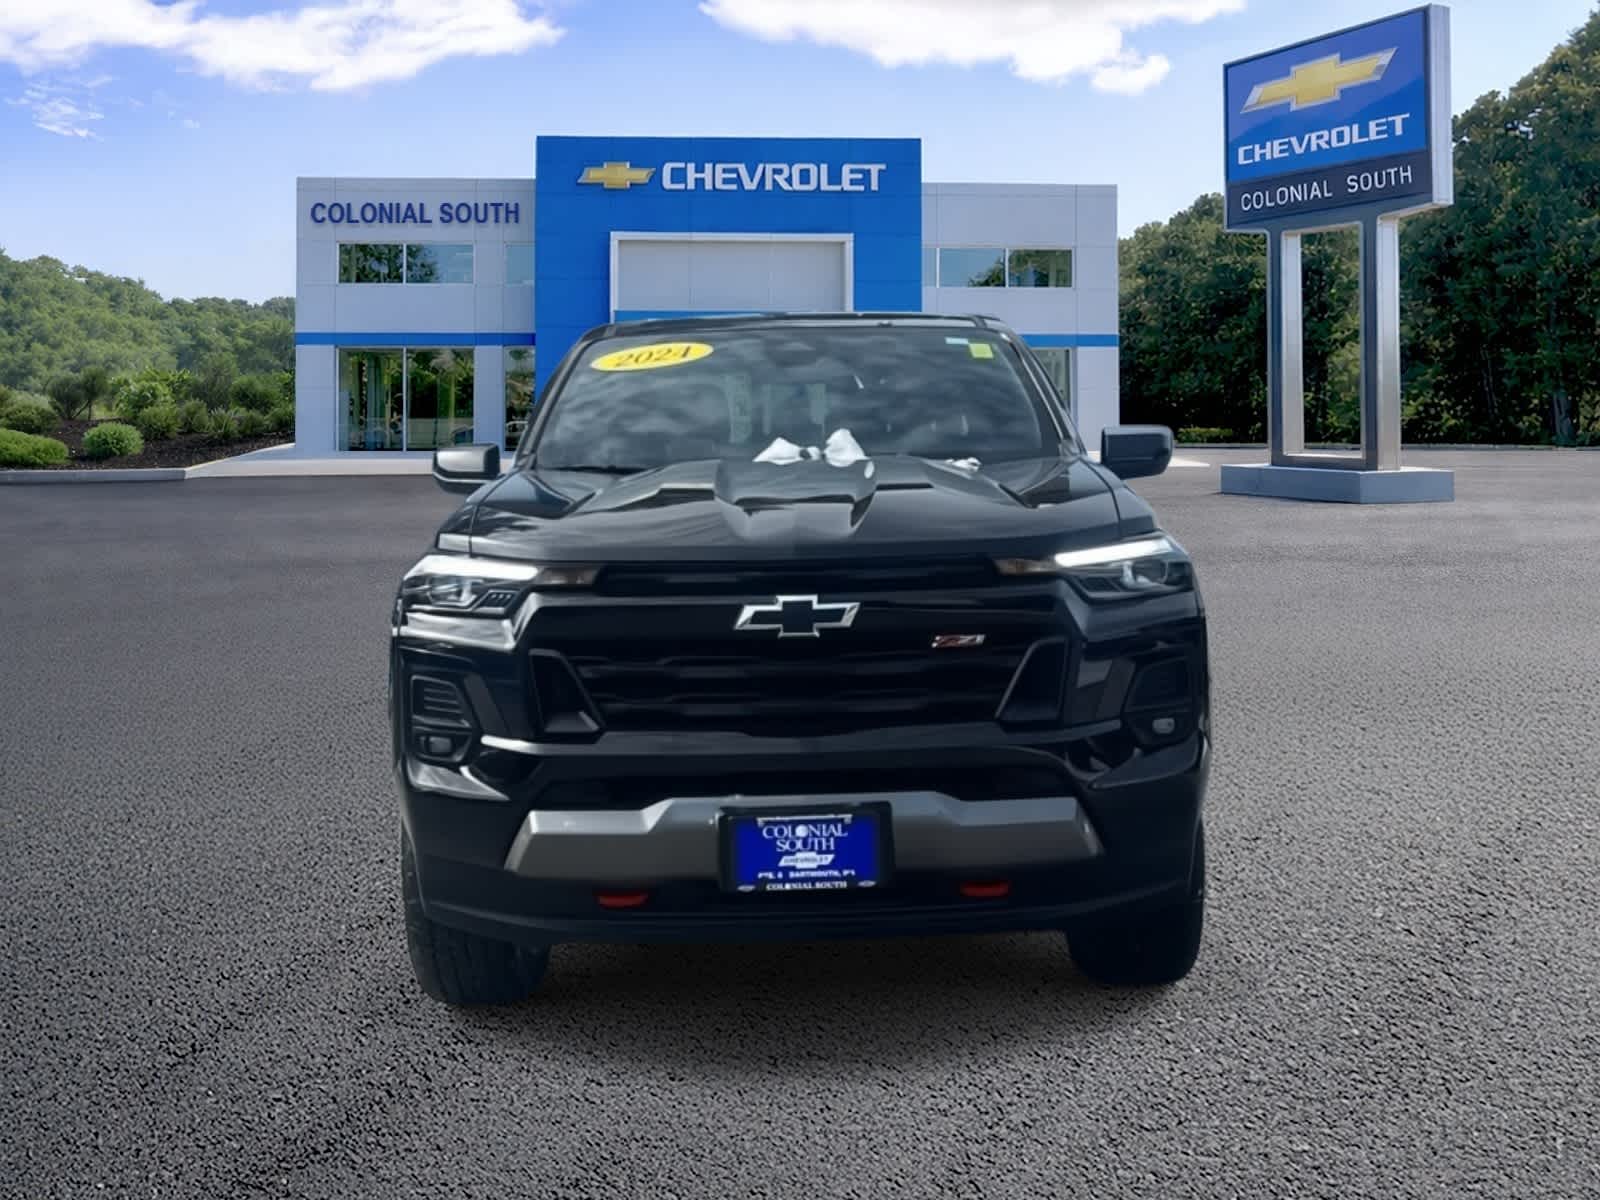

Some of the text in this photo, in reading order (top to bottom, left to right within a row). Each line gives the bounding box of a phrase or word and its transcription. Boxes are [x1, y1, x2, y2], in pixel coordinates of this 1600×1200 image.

[1238, 112, 1410, 165] CHEVROLET
[661, 161, 886, 193] CHEVROLET
[1240, 165, 1413, 212] COLONIAL SOUTH
[310, 202, 521, 225] COLONIAL SOUTH
[614, 346, 692, 367] 2024
[762, 823, 848, 839] COLONIAL
[776, 838, 835, 852] SOUTH
